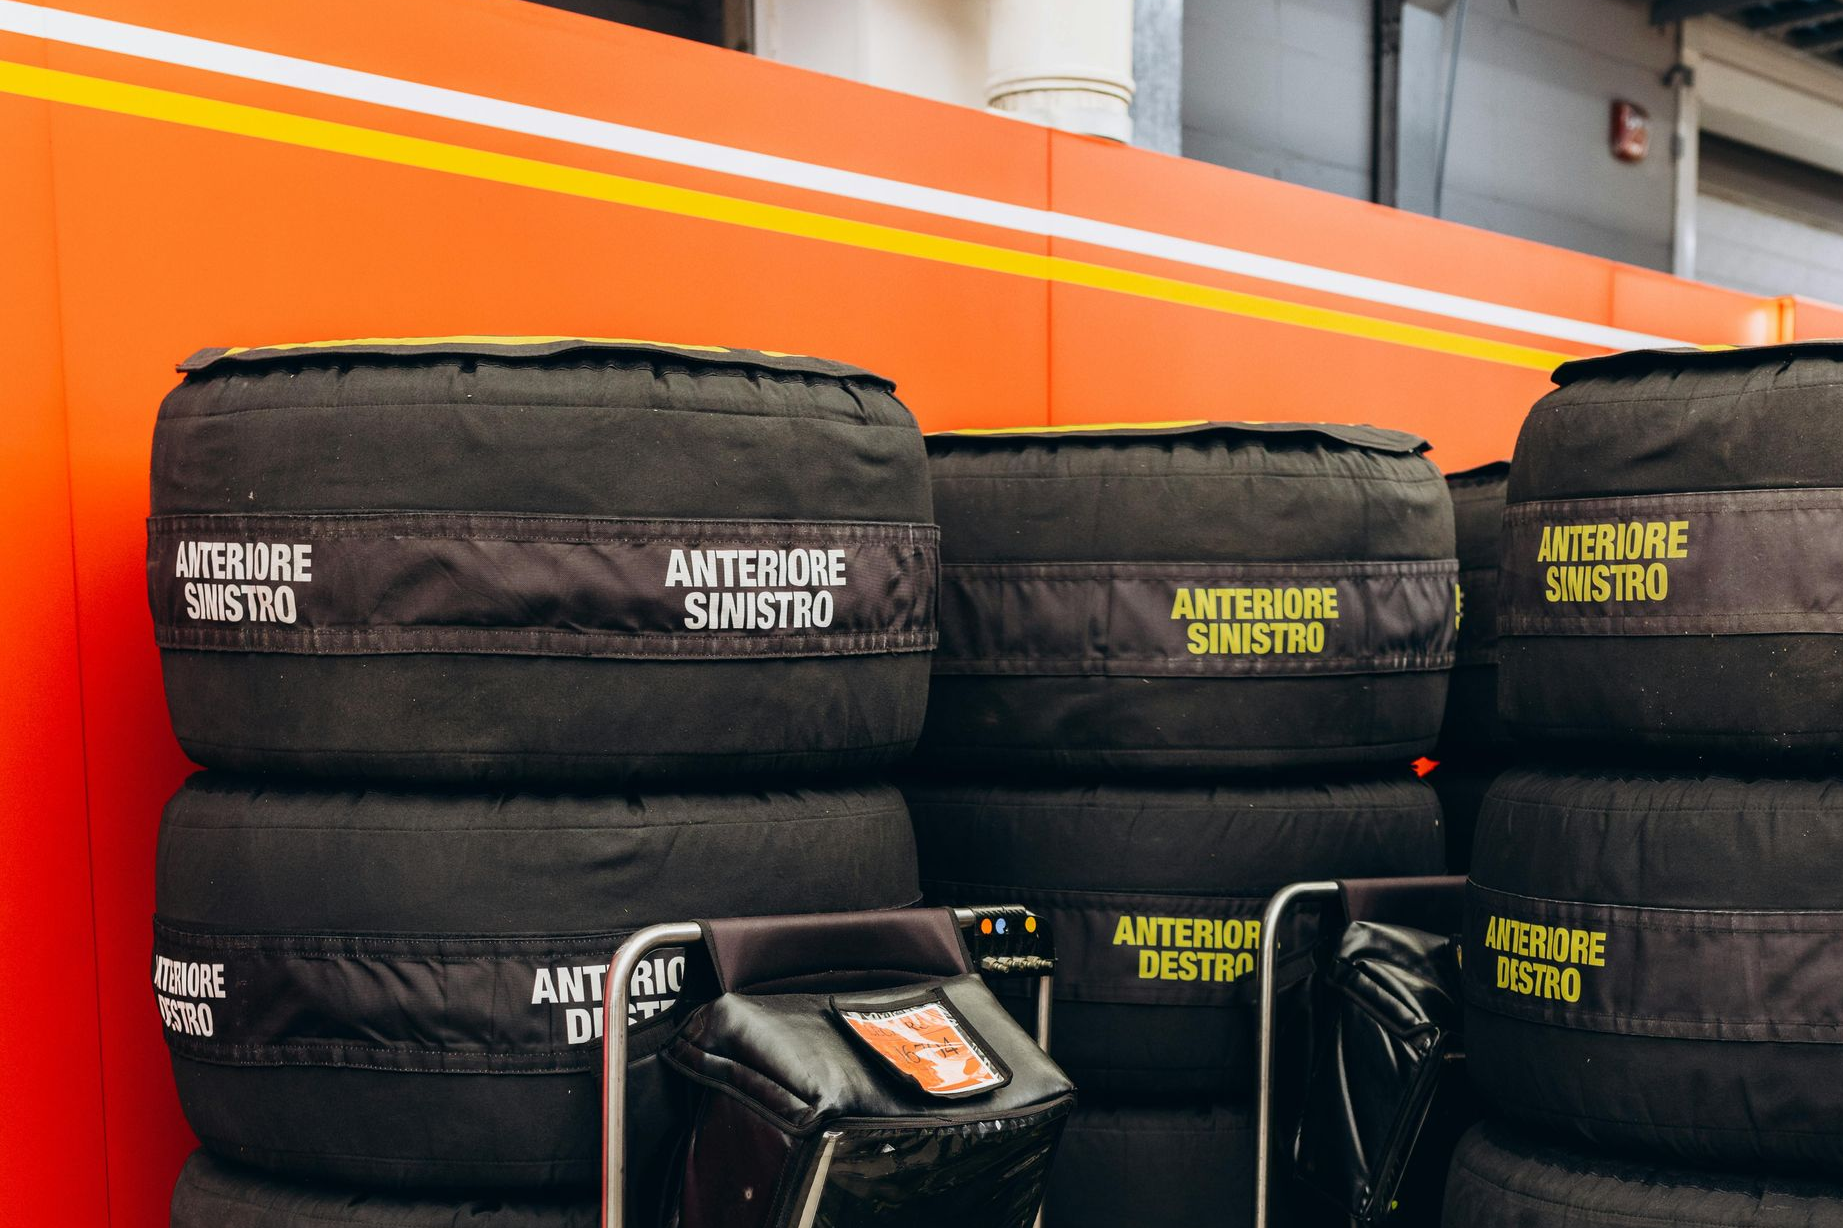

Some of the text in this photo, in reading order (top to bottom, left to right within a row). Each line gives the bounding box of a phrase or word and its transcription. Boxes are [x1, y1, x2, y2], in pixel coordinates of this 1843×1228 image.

[1538, 519, 1690, 562] ANTERIORE
[176, 541, 312, 582] ANTERIORE
[665, 548, 847, 588] ANTERIORE
[1545, 561, 1669, 603] SINISTRO
[184, 582, 297, 624] SINISTRO
[684, 590, 834, 630] SINISTRO
[1171, 586, 1340, 621] ANTERIORE
[1186, 620, 1325, 655] SINISTRO
[1112, 915, 1281, 950] ANTERIOR
[1485, 915, 1607, 967] ANTERIORE
[1138, 949, 1254, 983] DESTRO
[1496, 955, 1581, 1003] DESTRO
